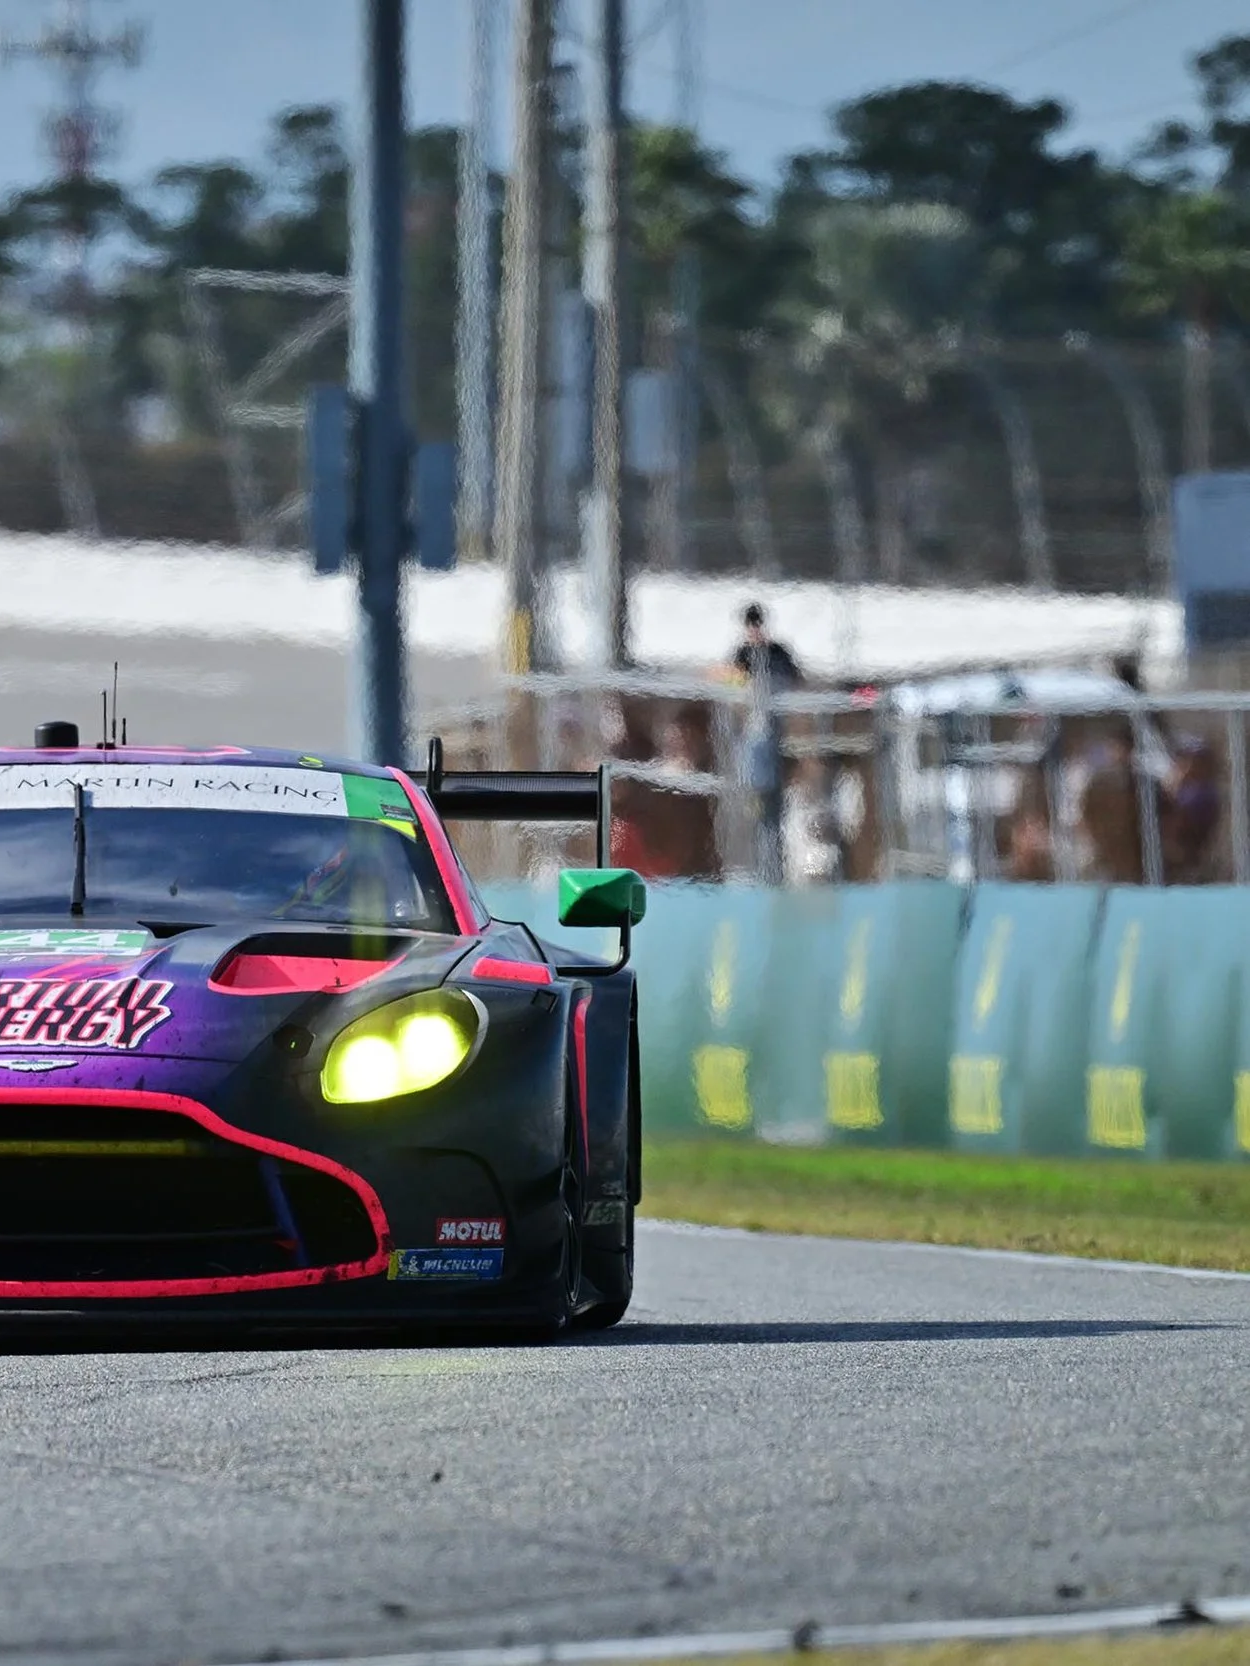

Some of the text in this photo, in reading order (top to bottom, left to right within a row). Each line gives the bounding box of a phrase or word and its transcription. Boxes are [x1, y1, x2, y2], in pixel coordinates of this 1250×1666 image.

[17, 777, 174, 790] MARTIN
[193, 779, 338, 803] RACING
[438, 1221, 503, 1241] MOTUL
[422, 1258, 494, 1271] MICHELIN
